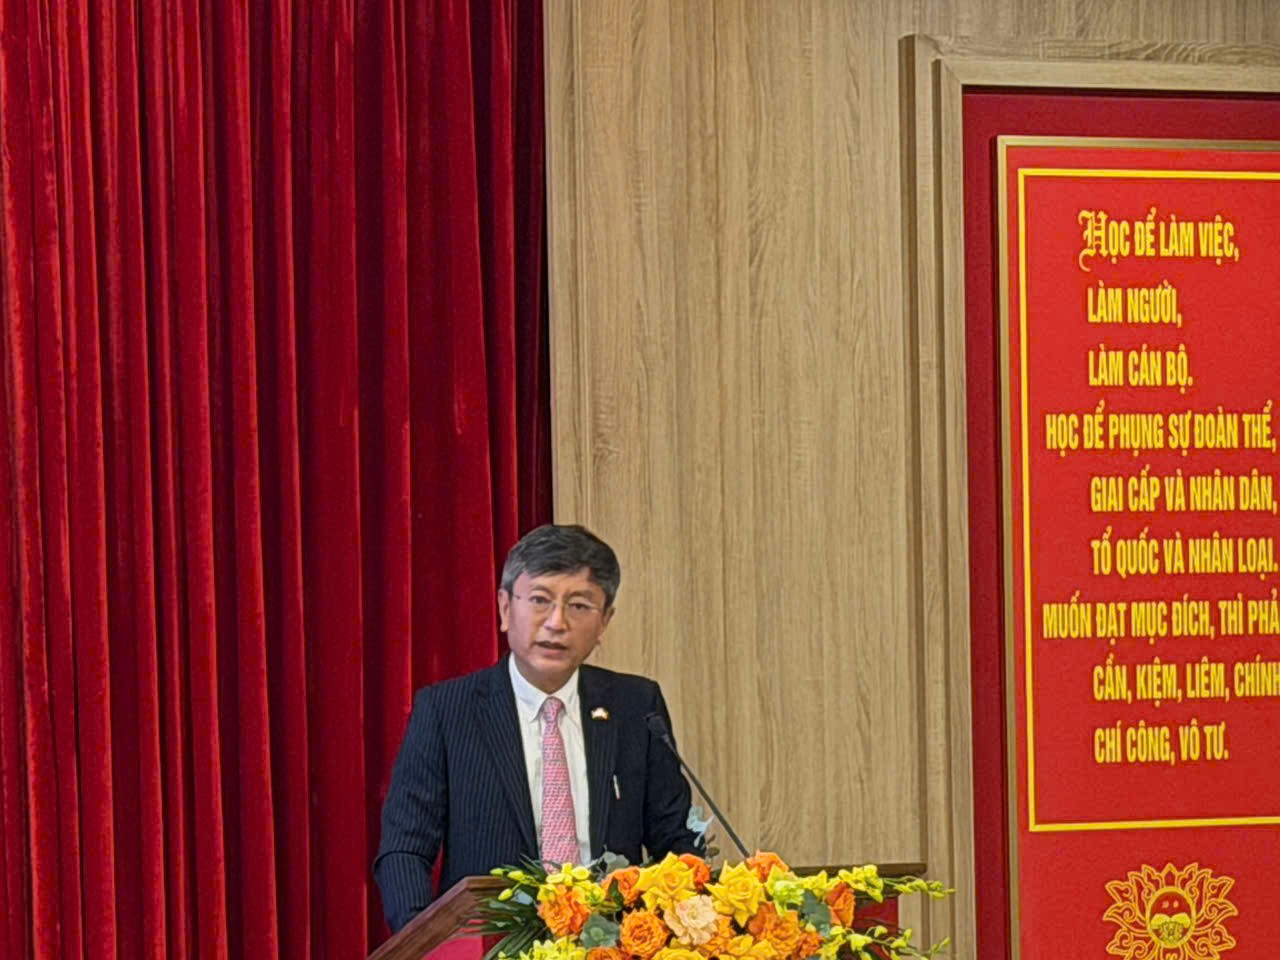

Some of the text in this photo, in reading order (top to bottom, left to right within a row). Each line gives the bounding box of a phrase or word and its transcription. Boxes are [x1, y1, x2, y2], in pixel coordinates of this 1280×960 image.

[1134, 206, 1156, 257] ĐỂ
[1159, 213, 1195, 257] LÀM
[1198, 214, 1240, 265] VIỆC,
[1087, 279, 1182, 328] LÀM NGƯỜI,
[1088, 343, 1124, 386] LÀM
[1128, 343, 1162, 386] CÁN
[1045, 399, 1277, 457] HỌC ĐỂ PHỤNG SỰ ĐOÀN THỂ,
[1091, 464, 1278, 515] GIAI CẤP VÀ NHÂN DÂN,
[1091, 525, 1279, 580] TỔ QUỐC VÀ NHÂN LOẠI.
[1043, 590, 1092, 639] MUỐN
[1096, 602, 1127, 645] ĐẠT
[1131, 601, 1168, 645] MỤC
[1172, 593, 1215, 640] ĐÍCH,
[1218, 593, 1244, 635] THÌ
[1093, 653, 1132, 704] CẦN,
[1136, 656, 1182, 707] KIỆM,
[1186, 656, 1230, 702] LIÊM,
[1094, 718, 1229, 766] CHÍ CÔNG, VÔ TƯ.
